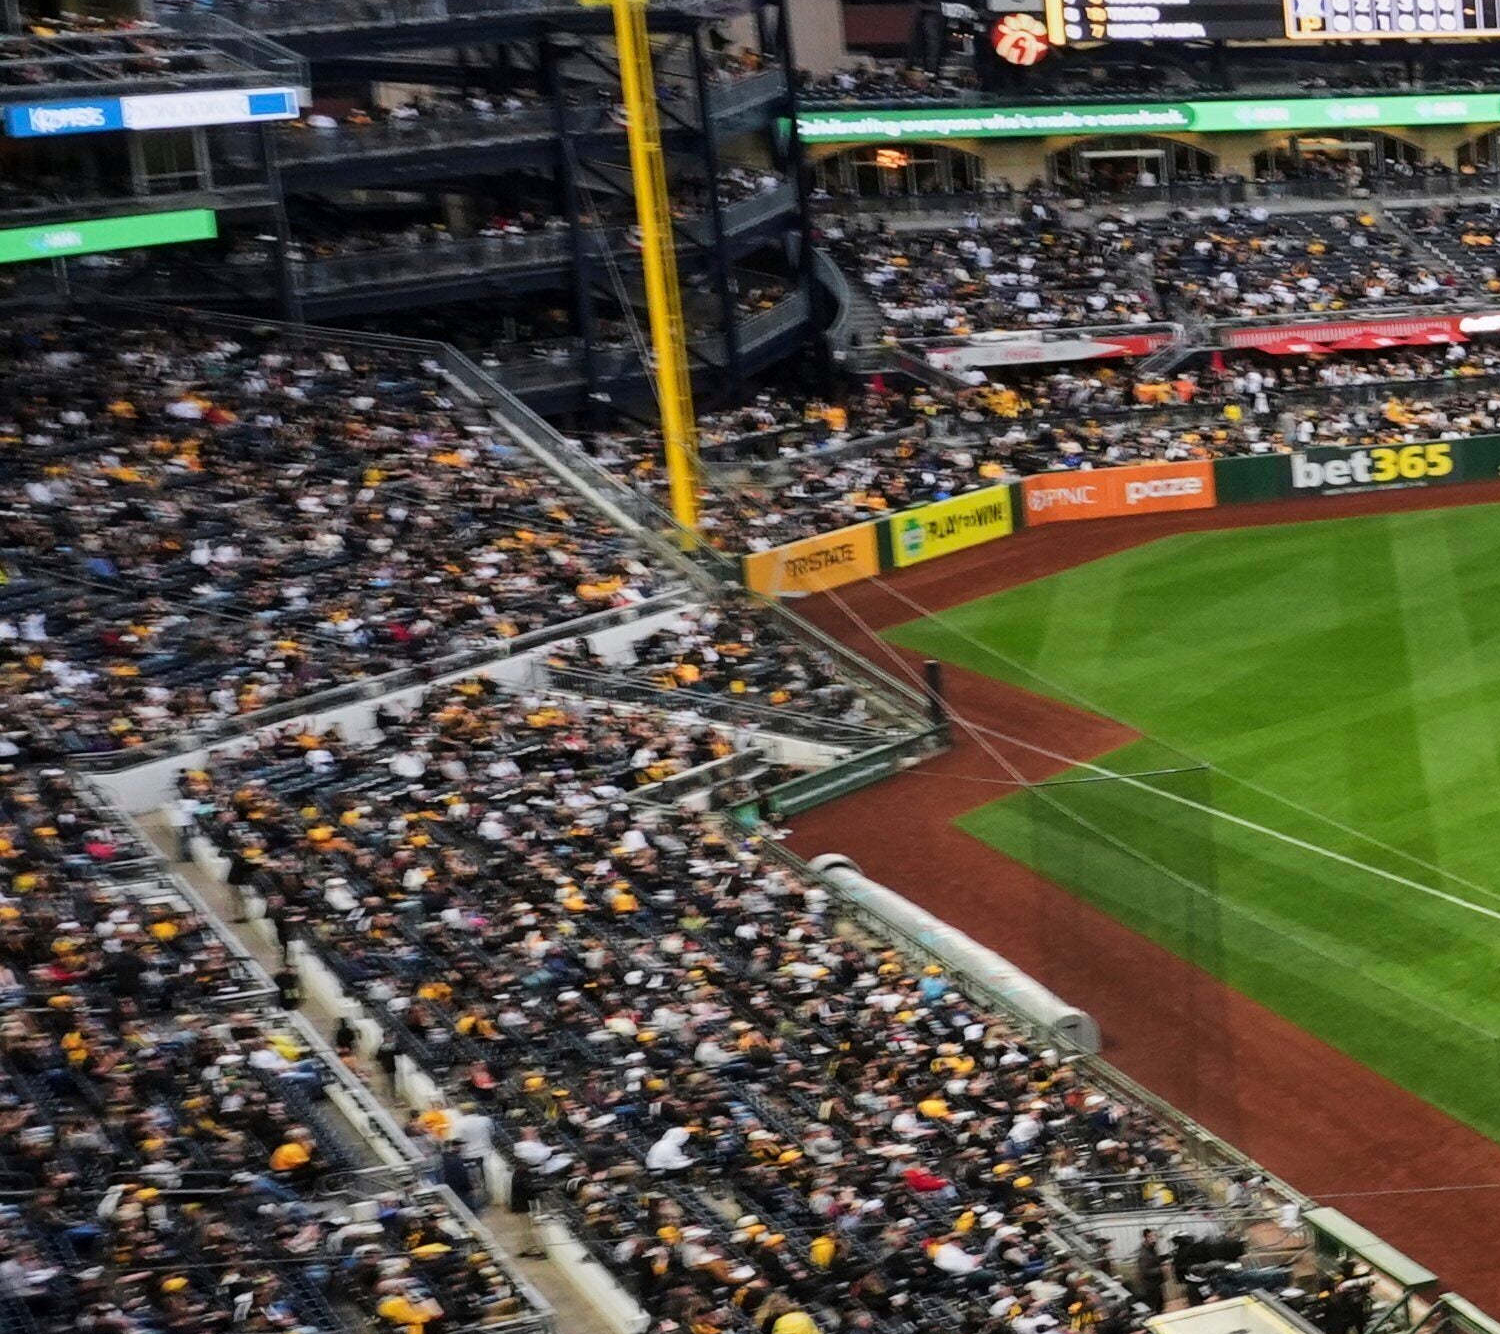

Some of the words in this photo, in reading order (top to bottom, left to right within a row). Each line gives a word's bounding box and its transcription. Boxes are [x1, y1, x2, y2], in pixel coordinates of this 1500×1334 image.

[1376, 13, 1392, 33] 1
[1289, 442, 1454, 489] bet365
[1045, 484, 1098, 507] PNC
[1125, 476, 1204, 505] paze
